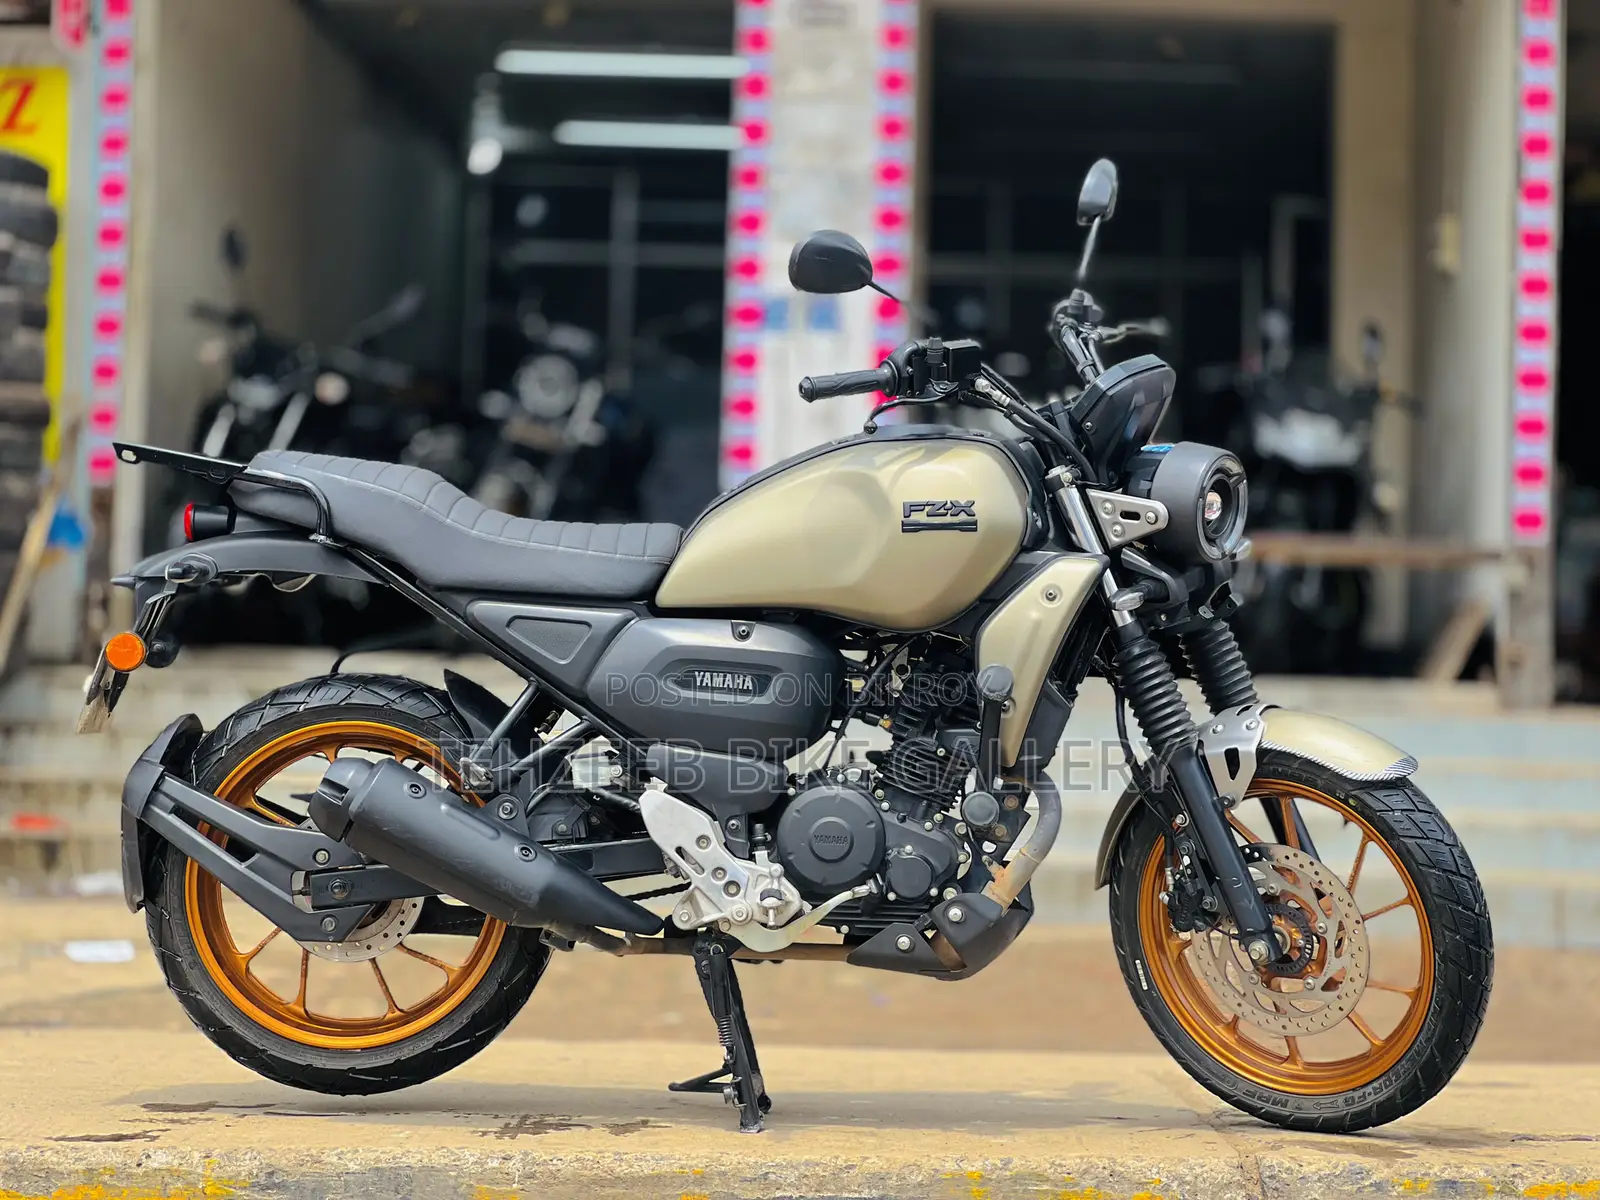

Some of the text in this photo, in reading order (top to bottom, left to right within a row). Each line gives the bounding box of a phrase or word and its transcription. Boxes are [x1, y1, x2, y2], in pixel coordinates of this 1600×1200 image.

[902, 500, 976, 518] FZ-X
[694, 671, 753, 690] YAMAHA
[813, 834, 849, 845] YAMAHA
[1242, 1088, 1288, 1109] MRF
